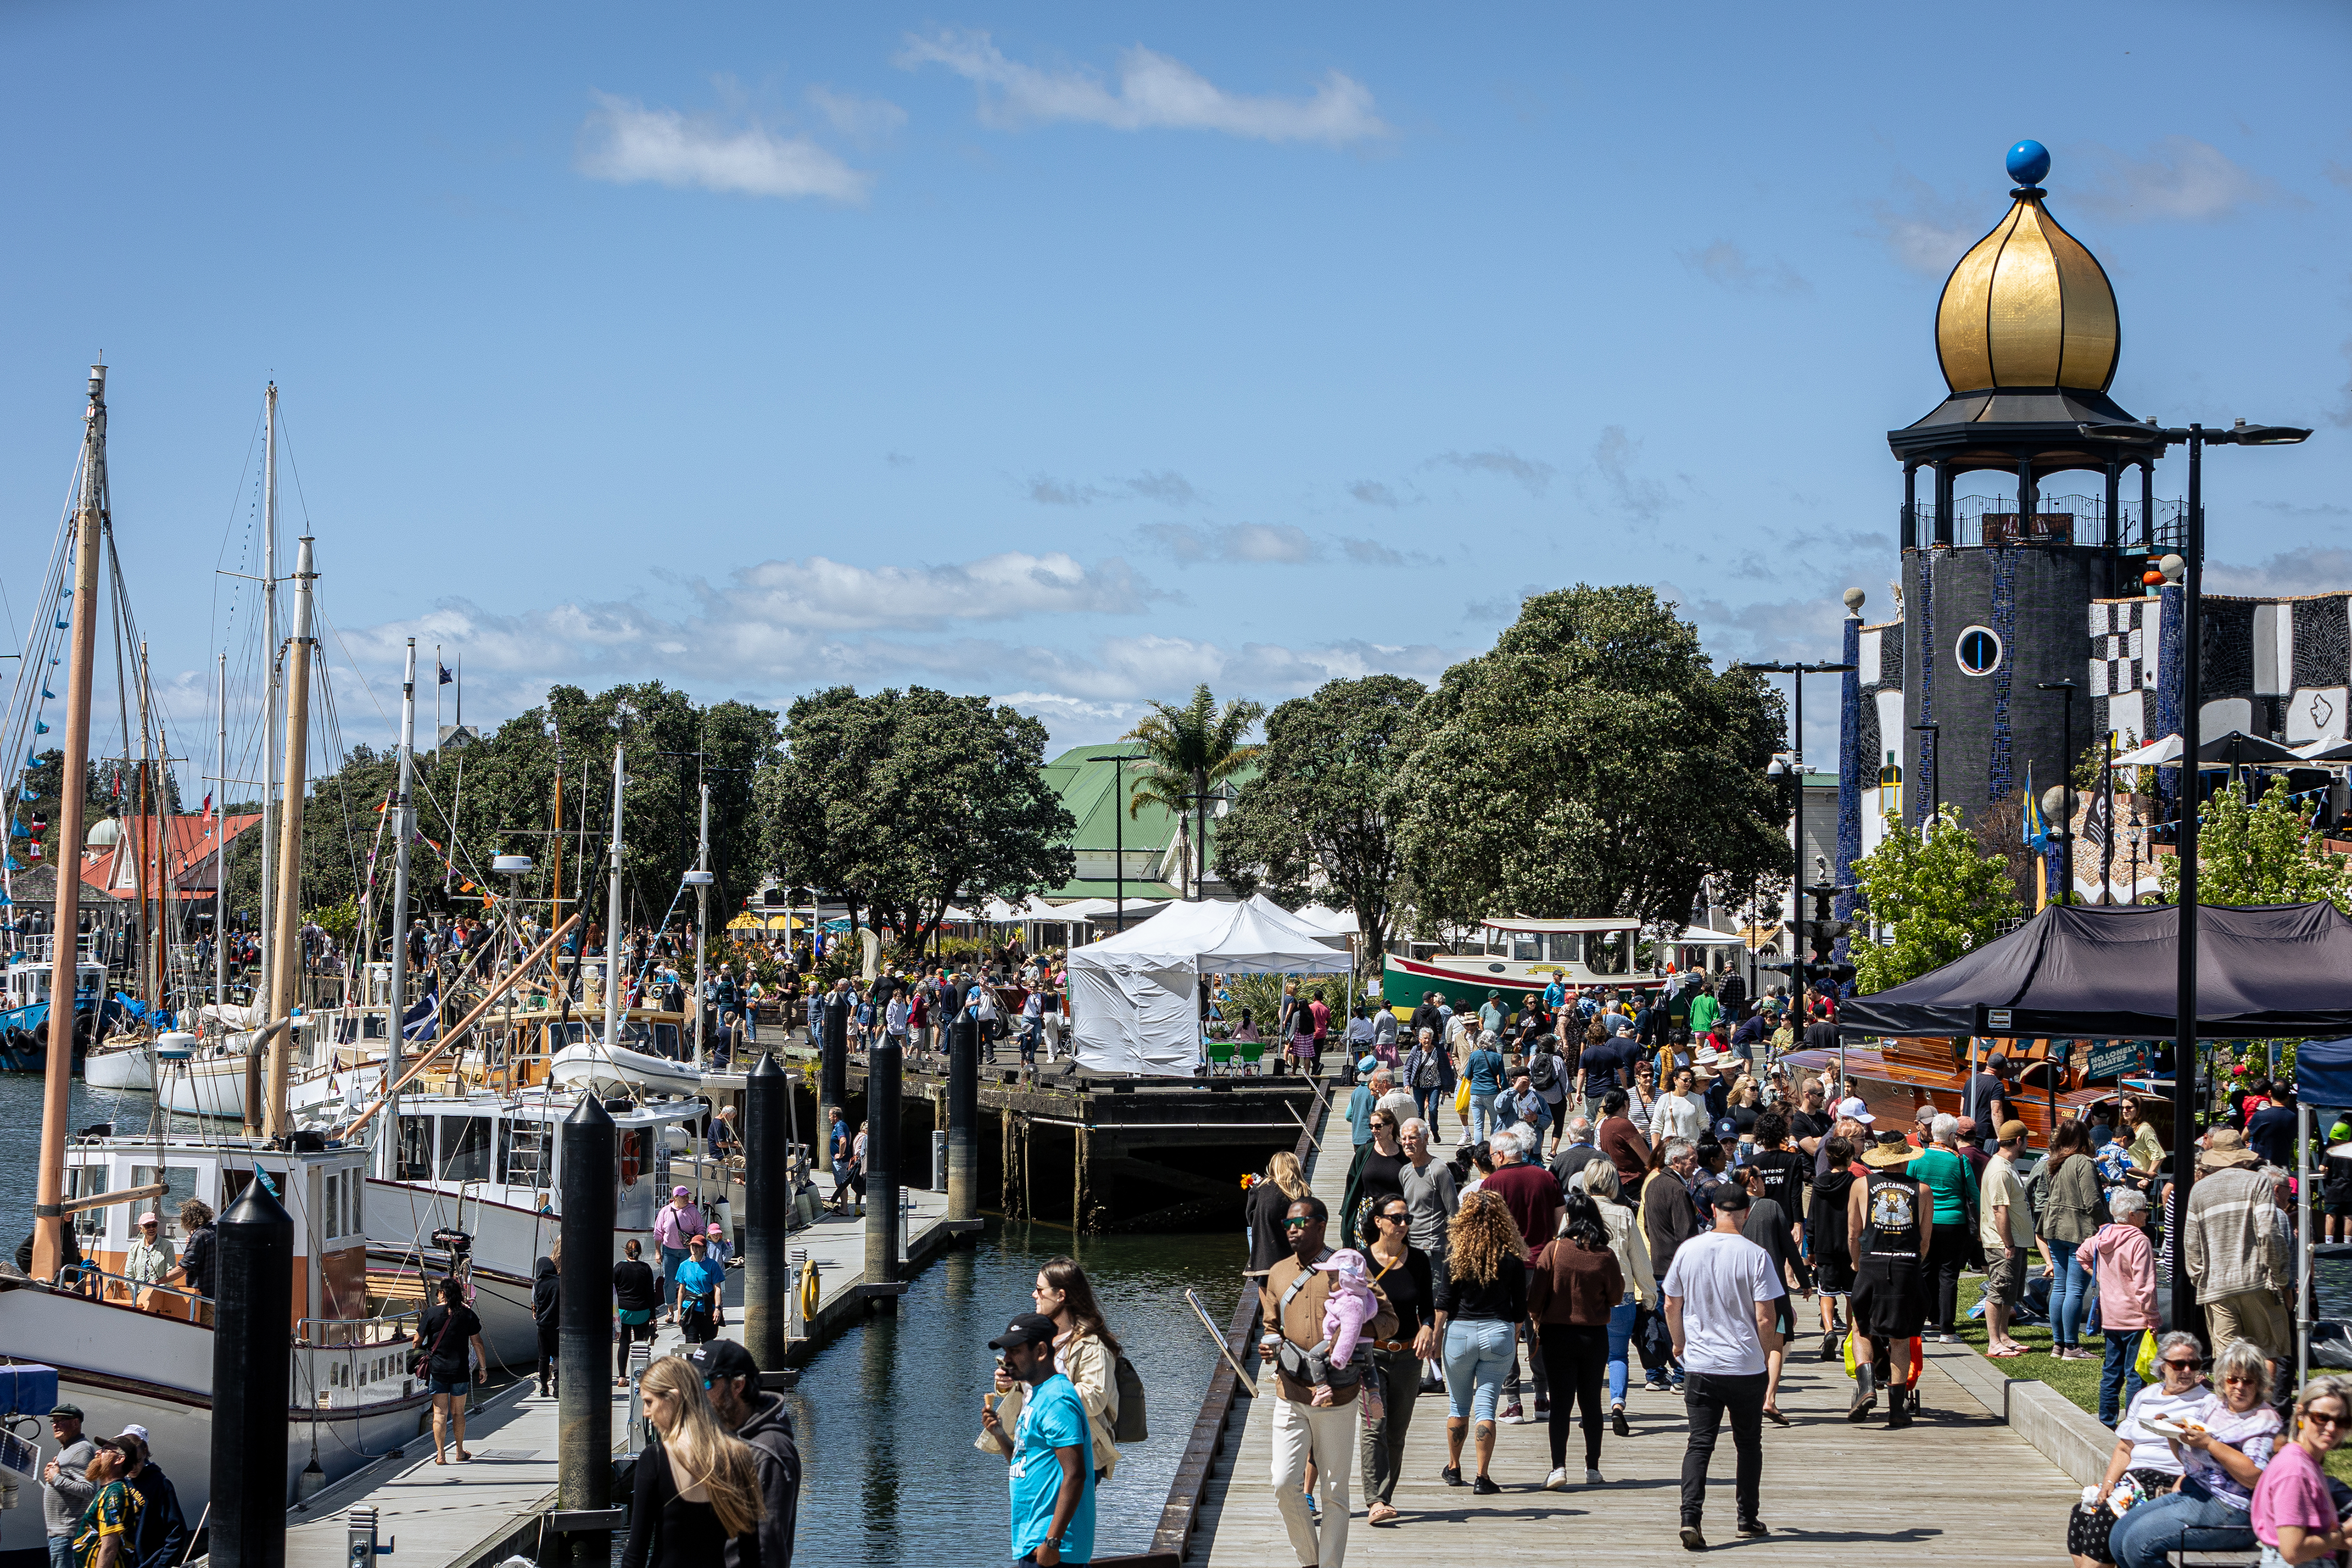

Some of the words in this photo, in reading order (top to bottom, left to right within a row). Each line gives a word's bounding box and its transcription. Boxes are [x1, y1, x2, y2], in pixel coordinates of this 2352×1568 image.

[2090, 1055, 2104, 1065] NO
[2105, 1044, 2137, 1060] LONELY
[2092, 1054, 2127, 1071] PIRATES
[1765, 1176, 1784, 1185] REW
[1869, 1182, 1888, 1194] LOOSE
[1888, 1182, 1915, 1195] CANNONS
